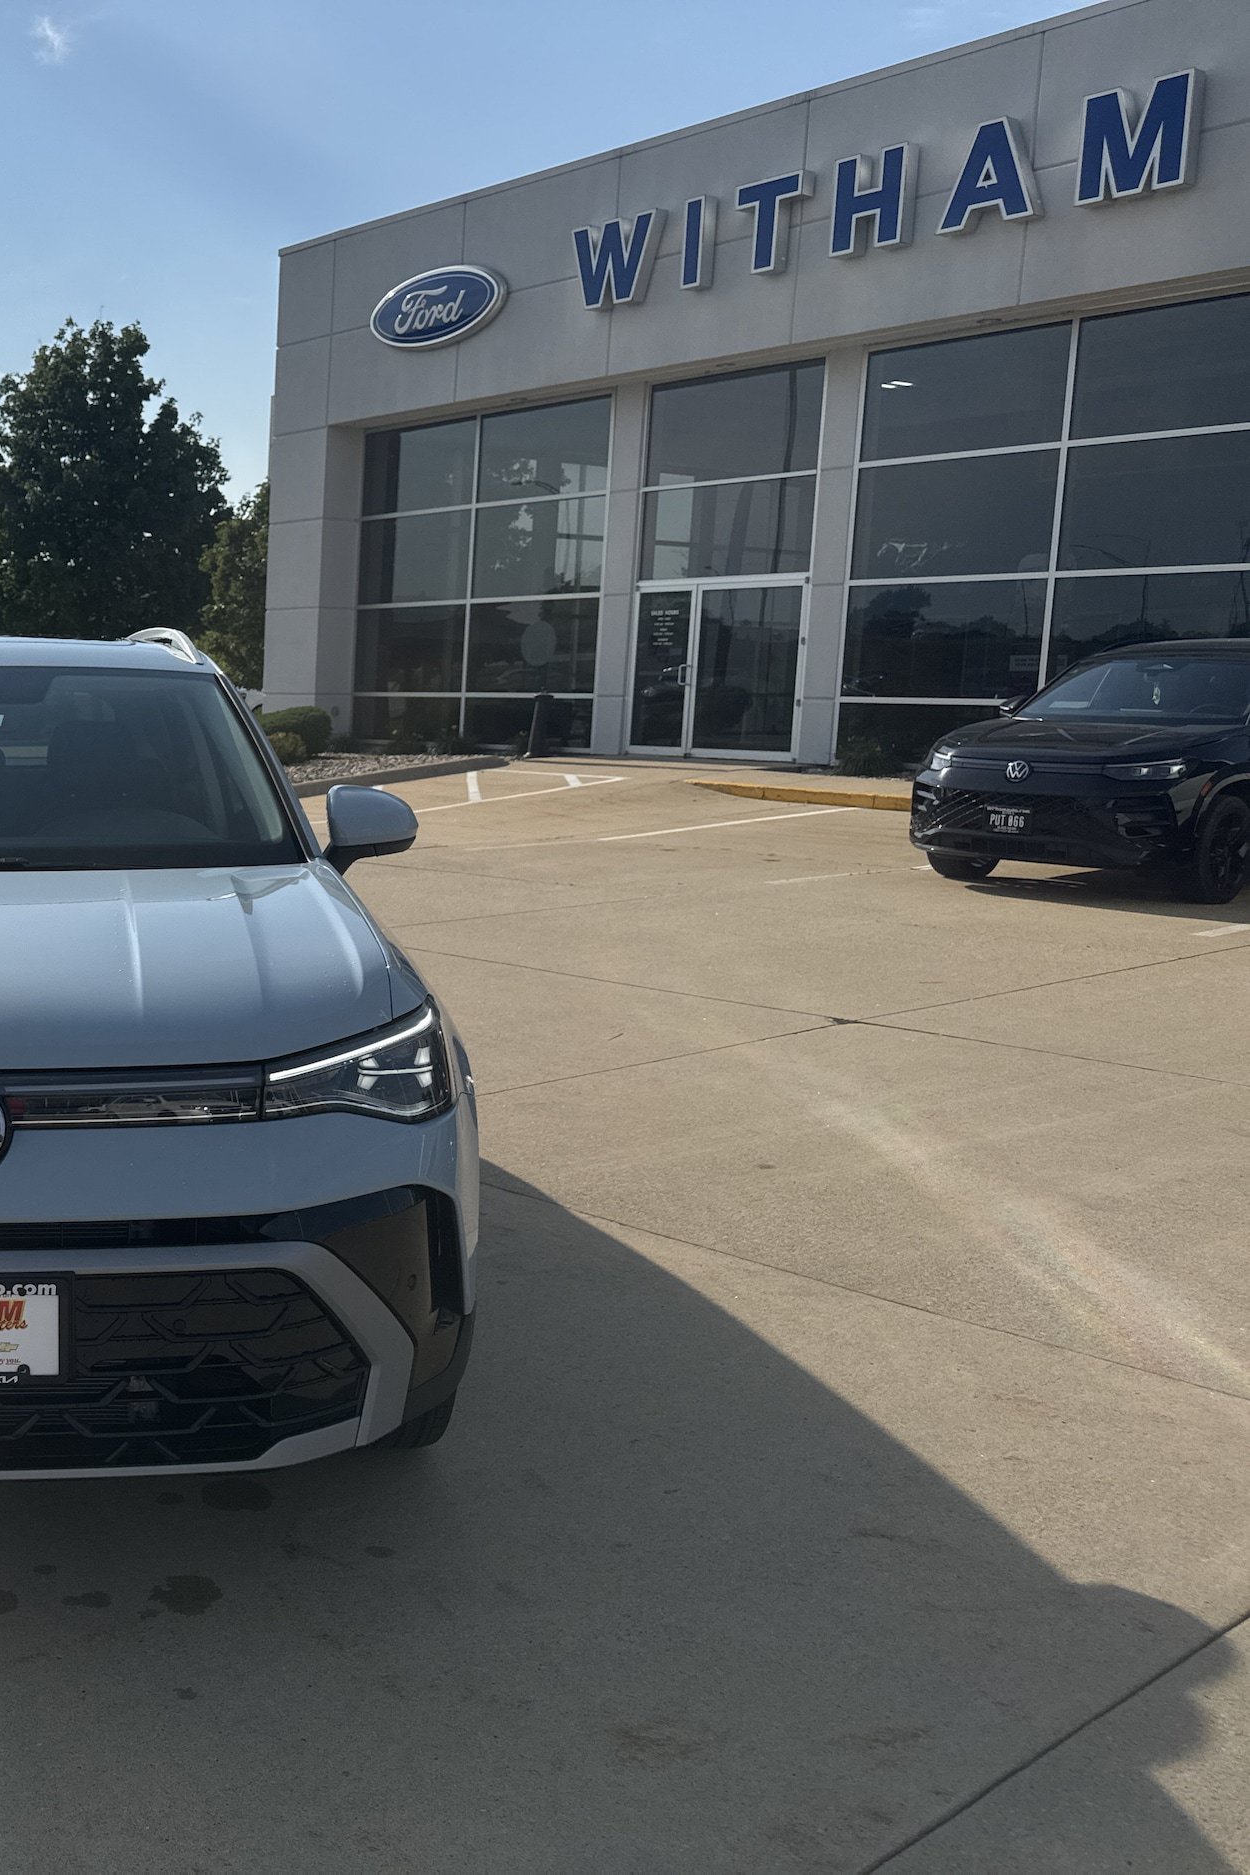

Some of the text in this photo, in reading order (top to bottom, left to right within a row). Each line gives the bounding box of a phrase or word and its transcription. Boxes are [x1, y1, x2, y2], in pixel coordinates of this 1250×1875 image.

[571, 67, 1206, 312] WITHAM
[394, 285, 466, 335] Ford
[989, 813, 1006, 826] PUT
